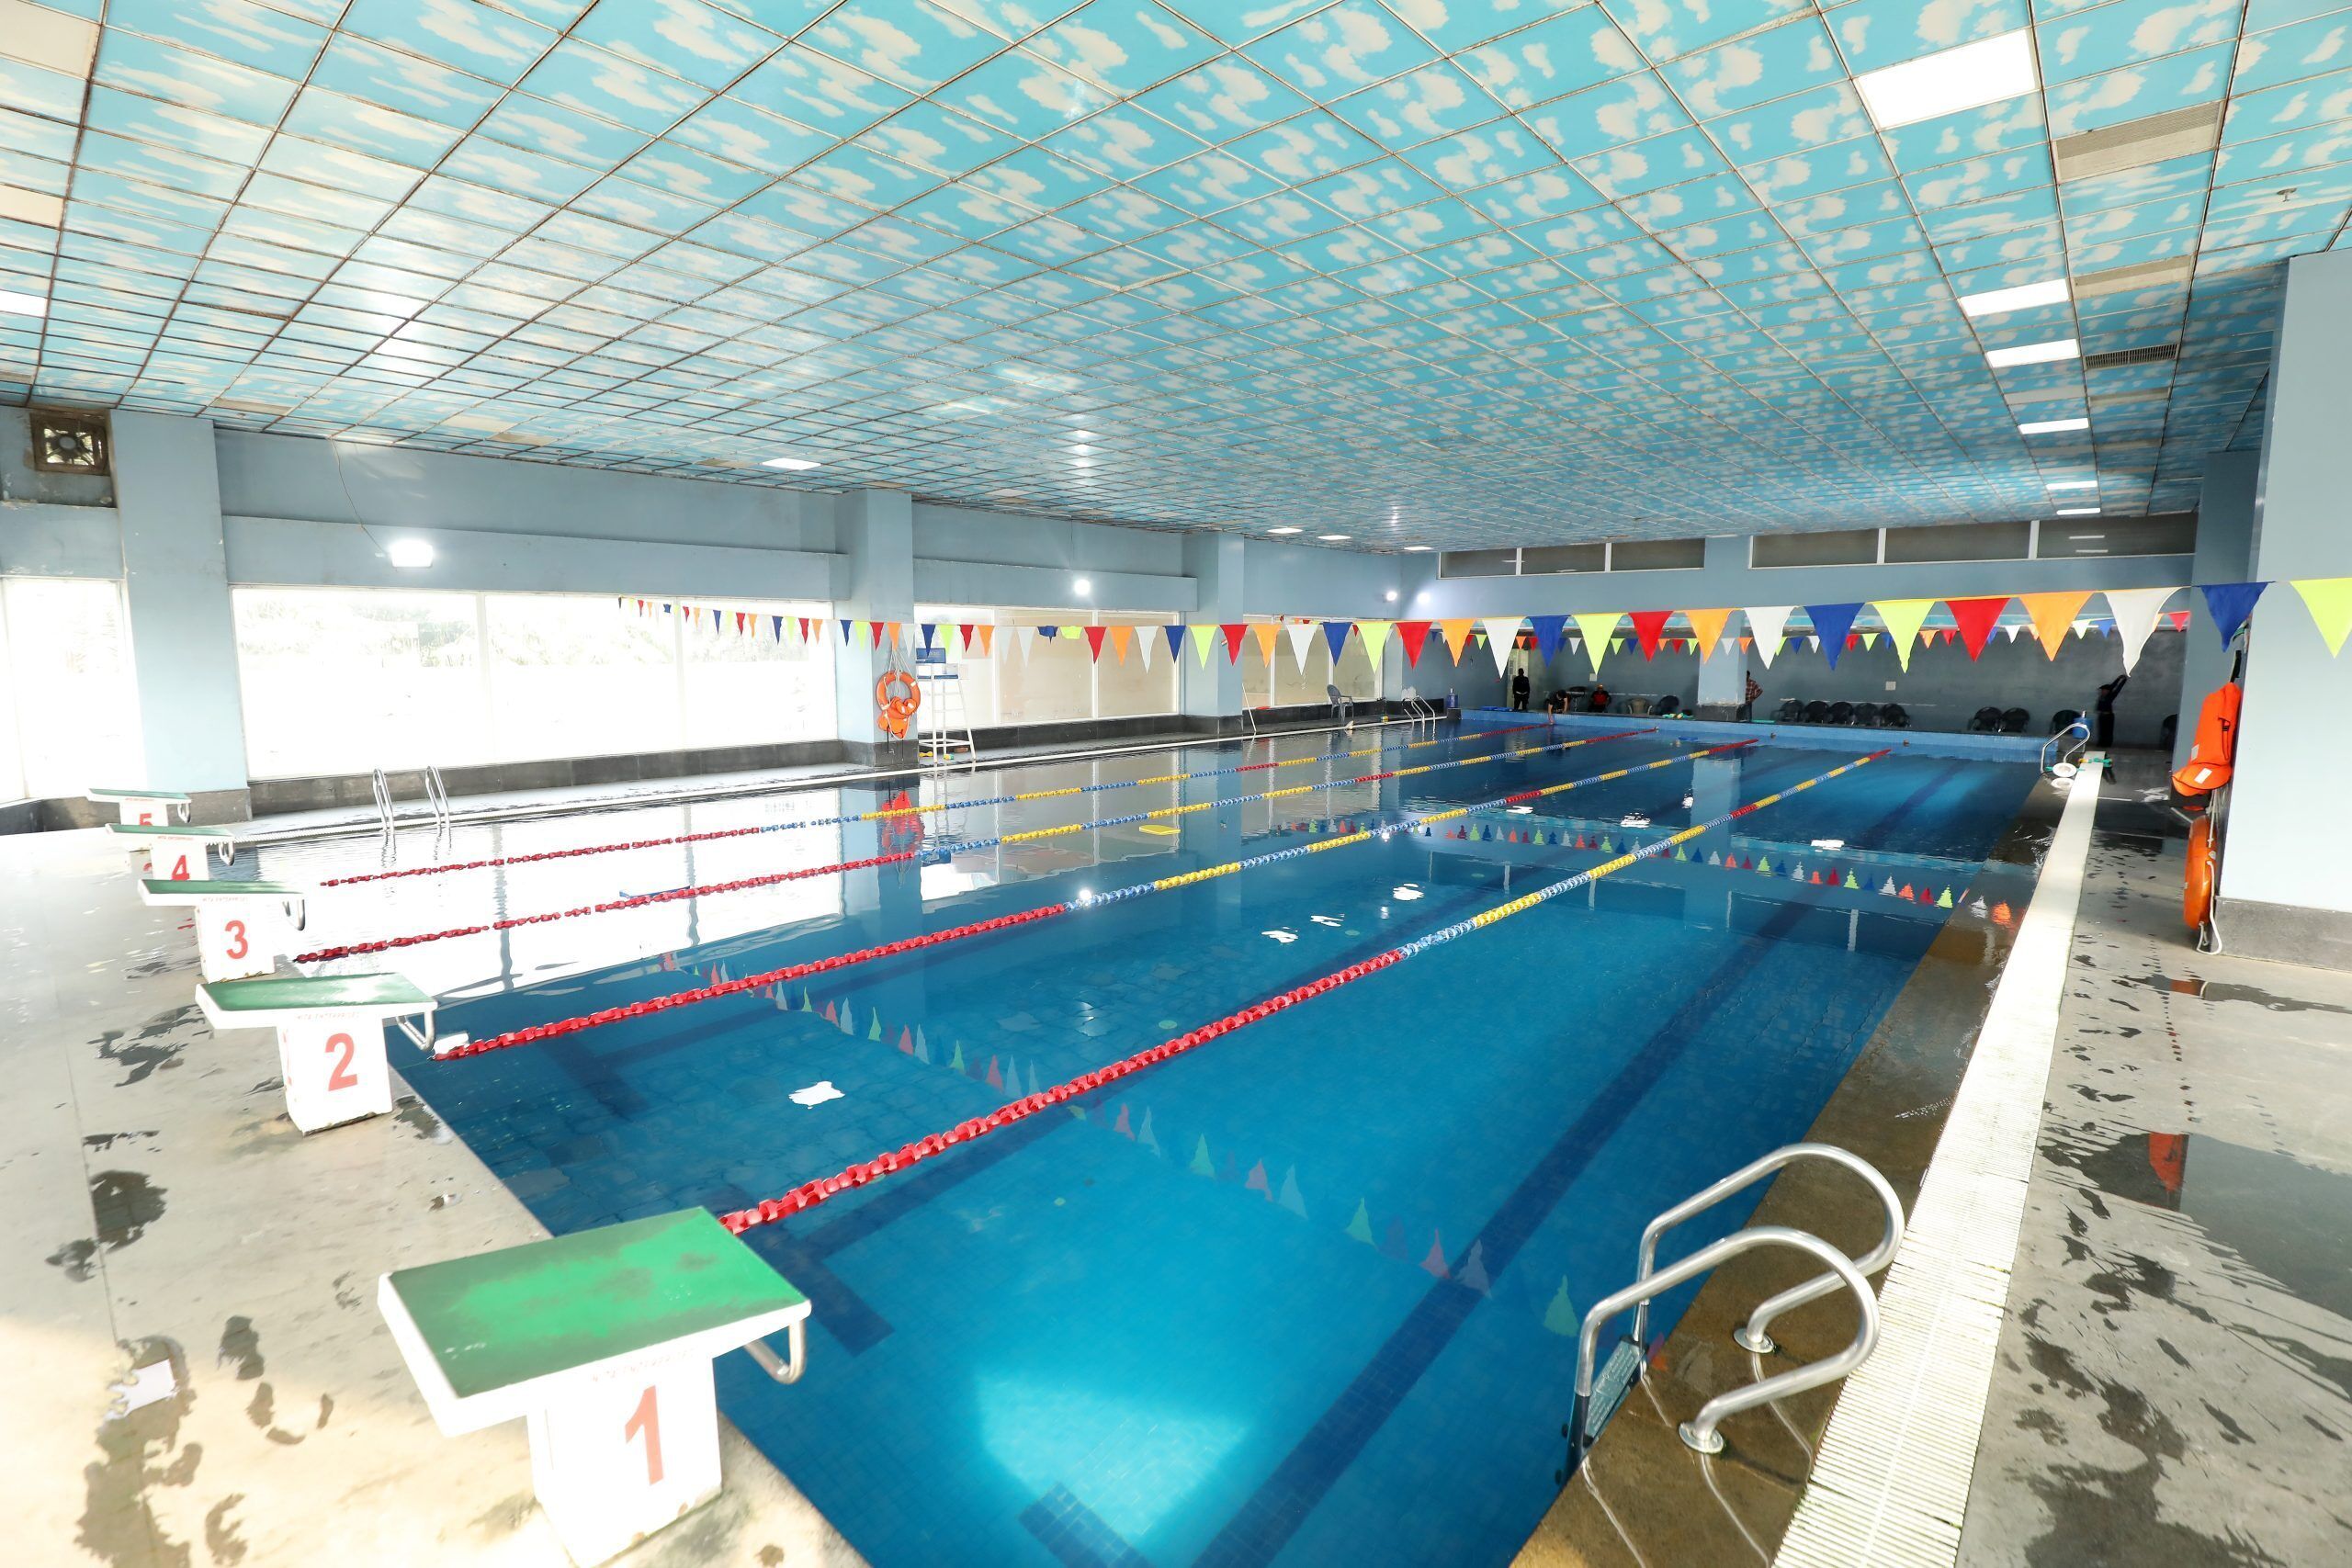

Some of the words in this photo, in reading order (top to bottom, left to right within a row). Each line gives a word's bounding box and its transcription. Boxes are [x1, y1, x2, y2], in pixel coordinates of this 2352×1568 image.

[139, 813, 153, 826] 5
[170, 854, 190, 881] 4
[224, 919, 249, 960] 3
[324, 1032, 358, 1091] 2
[625, 1385, 663, 1485] 1
